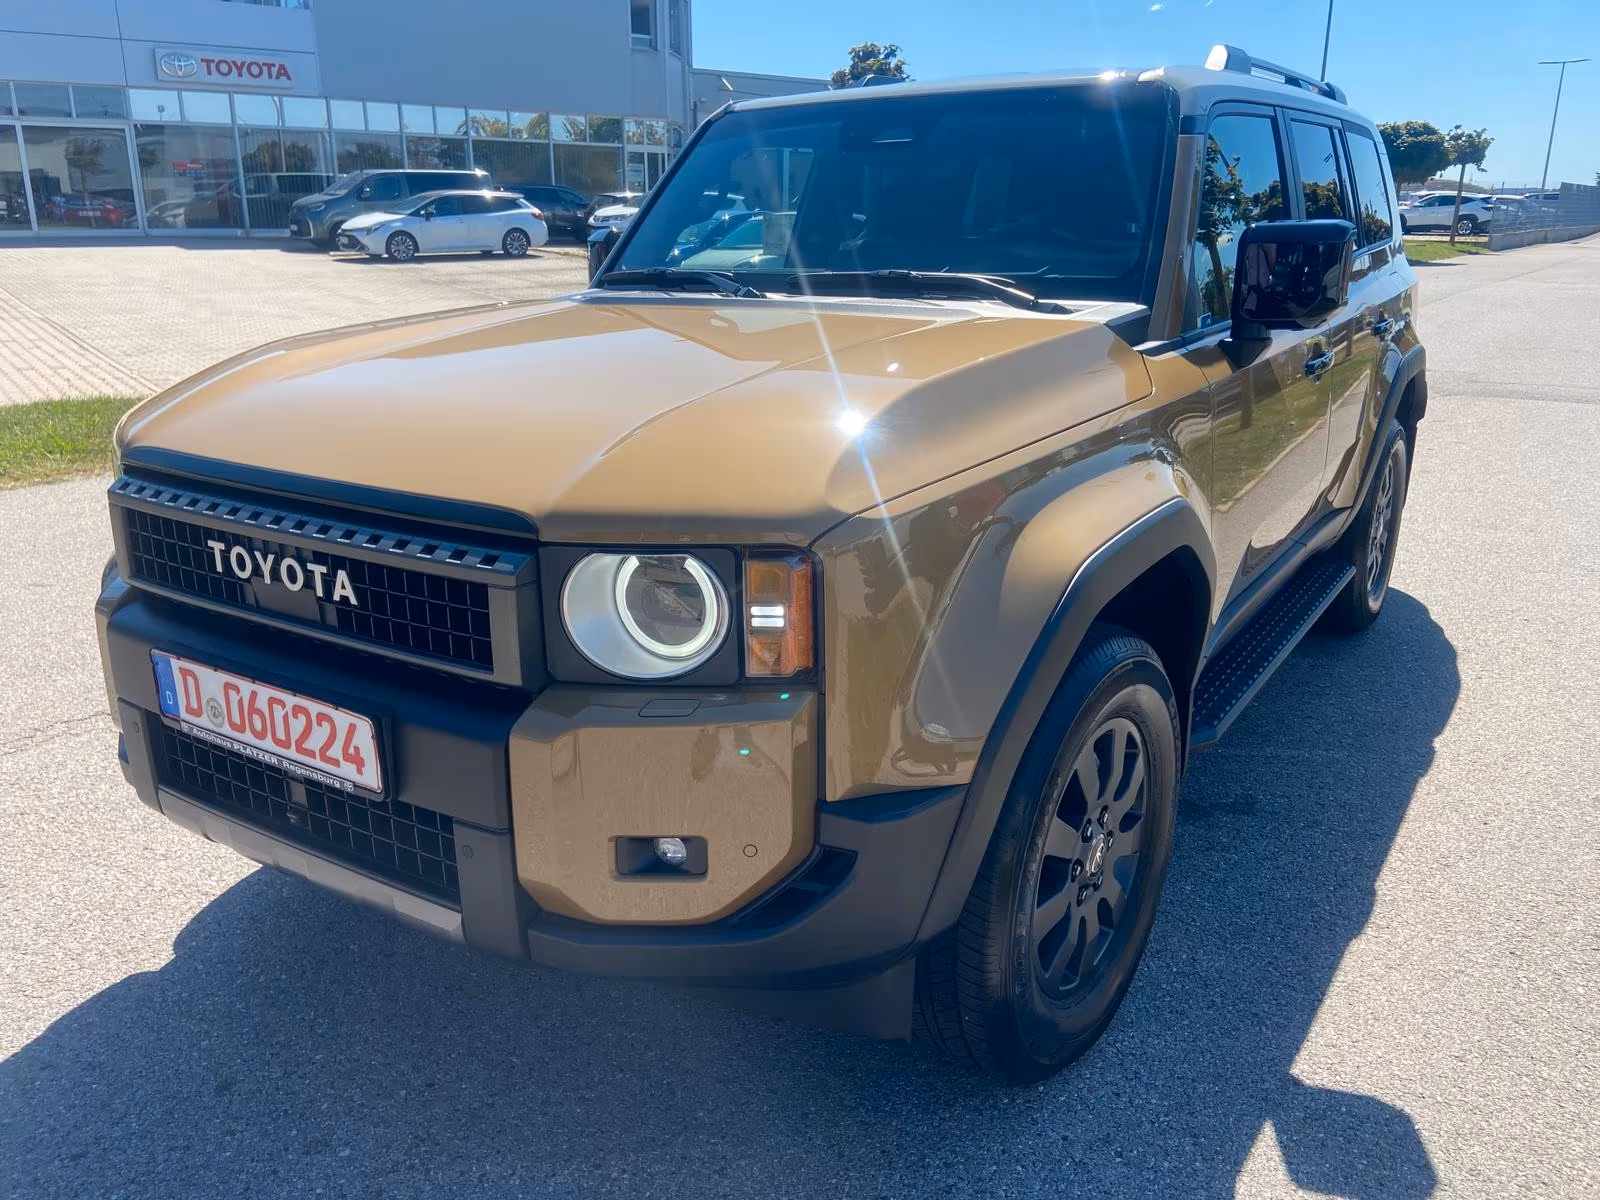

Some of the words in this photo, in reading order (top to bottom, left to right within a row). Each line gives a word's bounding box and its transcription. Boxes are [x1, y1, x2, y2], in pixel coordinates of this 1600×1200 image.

[201, 58, 292, 81] TOYOTA
[207, 539, 358, 606] TOYOTA
[166, 691, 174, 705] D
[179, 667, 203, 718] D
[223, 682, 366, 776] 060224
[193, 728, 232, 749] Autohaus
[233, 743, 279, 766] PLATZER
[282, 760, 341, 789] Regensburg
